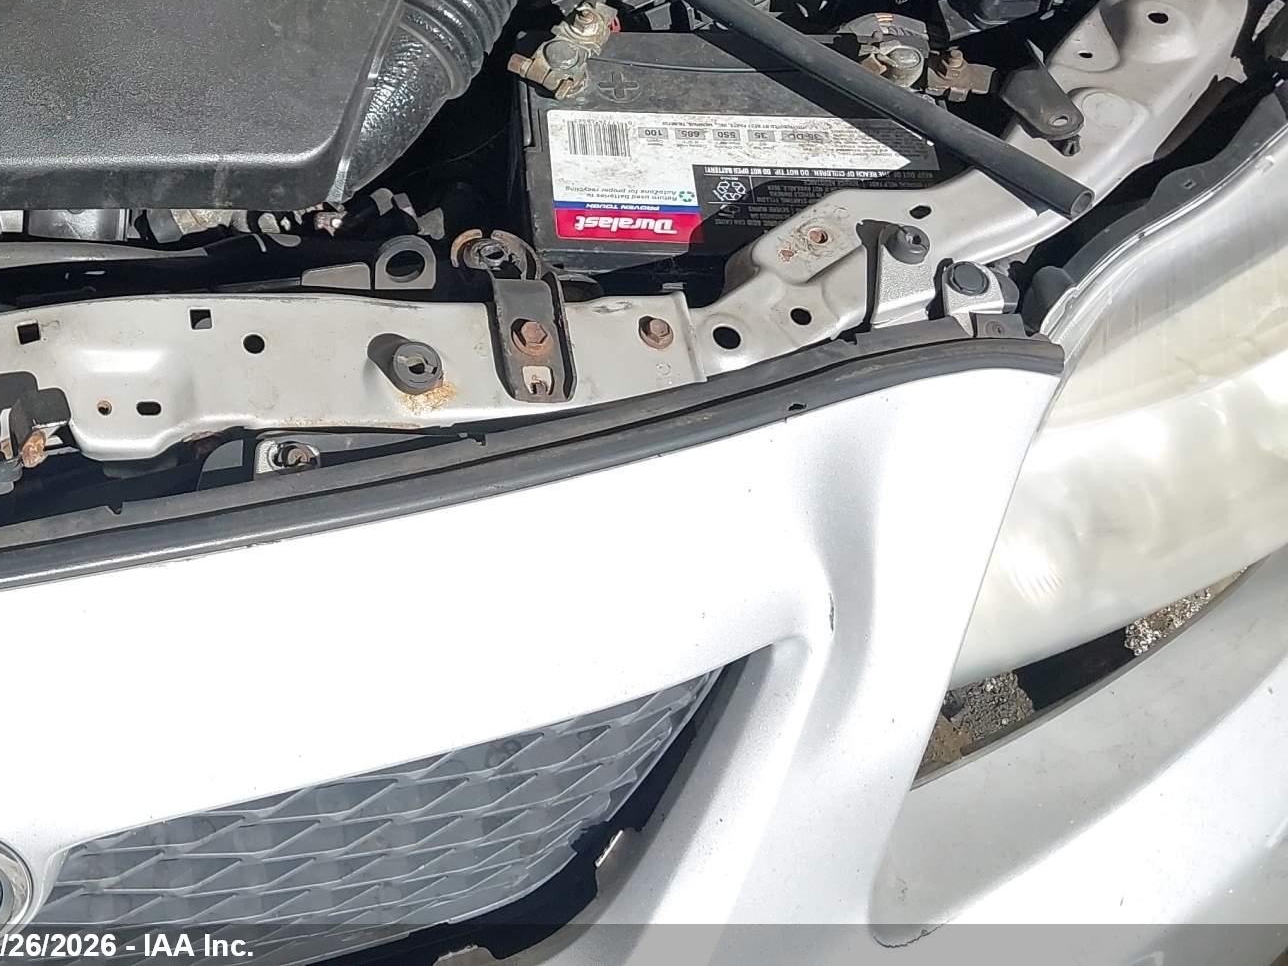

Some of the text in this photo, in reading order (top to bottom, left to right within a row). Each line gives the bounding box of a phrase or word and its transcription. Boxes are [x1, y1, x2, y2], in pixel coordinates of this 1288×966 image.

[644, 128, 664, 136] 100
[717, 131, 737, 139] 550
[754, 131, 768, 139] 35
[751, 167, 762, 175] NOT
[786, 168, 799, 176] NOT
[565, 185, 600, 193] recycling
[585, 202, 619, 210] TOUGH
[574, 215, 678, 234] Duralast
